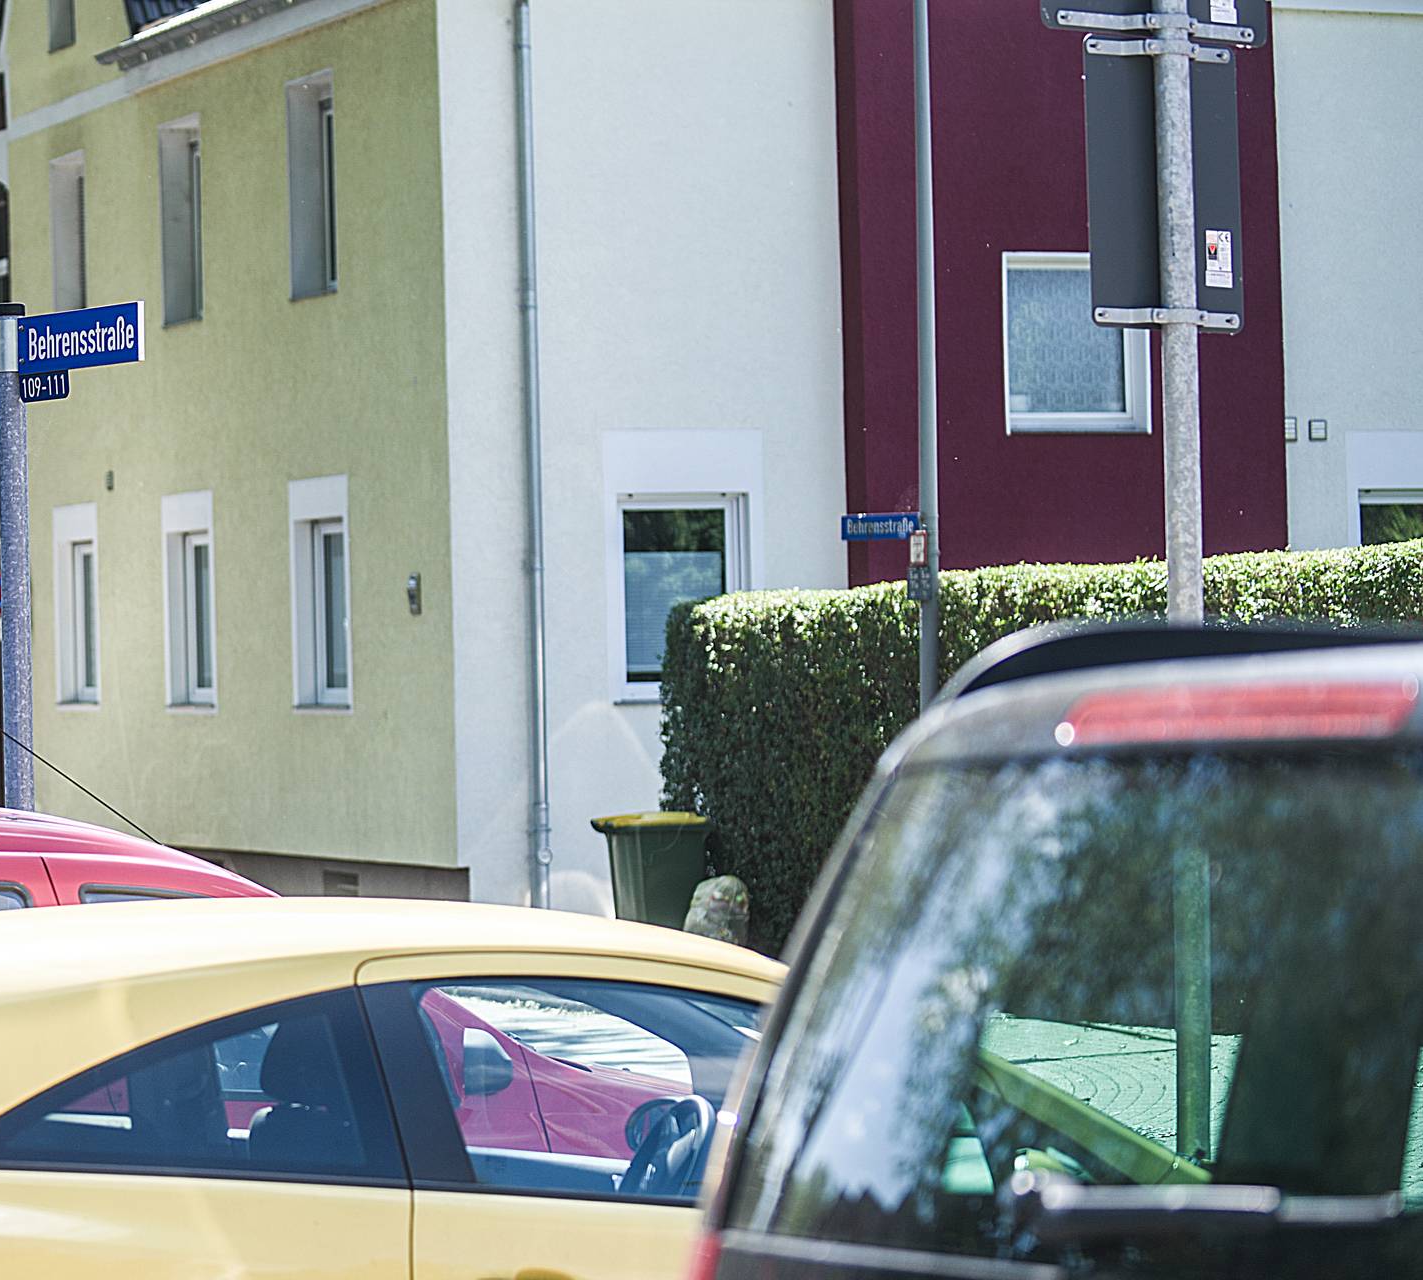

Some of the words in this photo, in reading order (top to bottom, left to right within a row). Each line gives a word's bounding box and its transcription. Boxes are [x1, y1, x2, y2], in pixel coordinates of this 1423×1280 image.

[29, 316, 135, 361] Behrensstraße
[22, 374, 66, 398] 109-111
[847, 517, 914, 535] Behrensstraße
